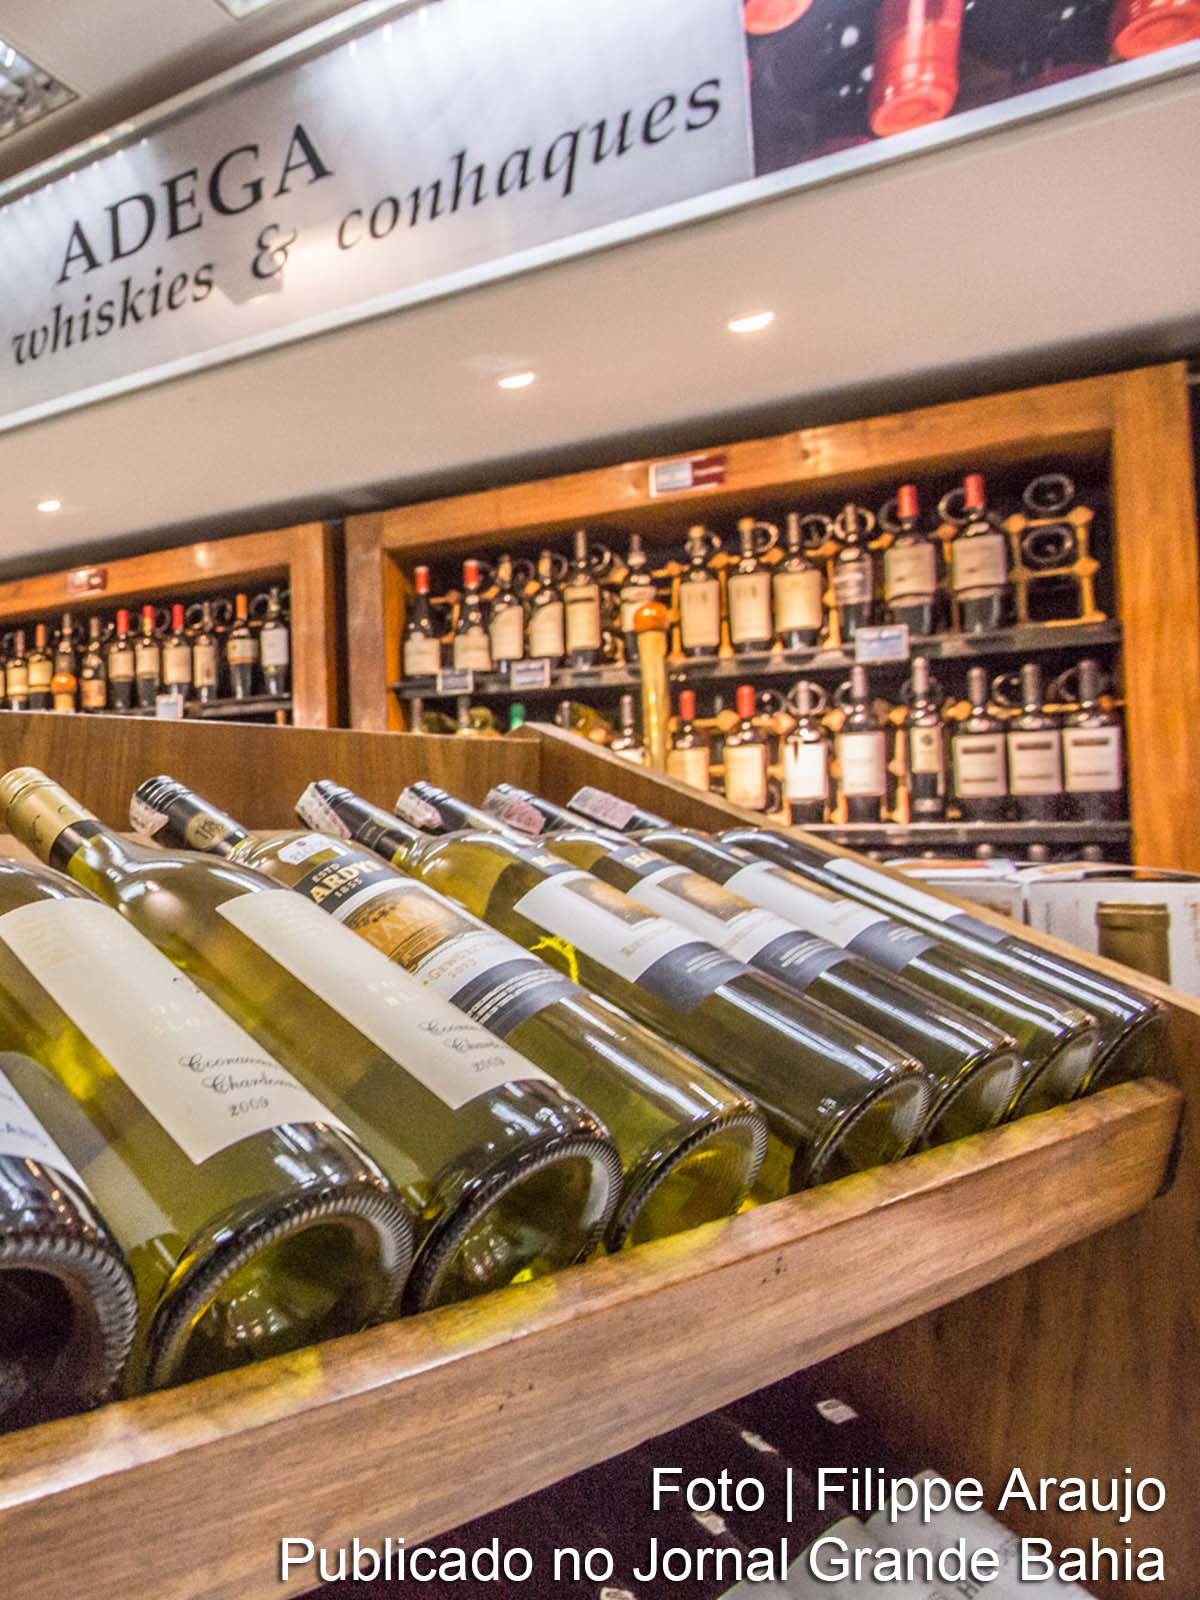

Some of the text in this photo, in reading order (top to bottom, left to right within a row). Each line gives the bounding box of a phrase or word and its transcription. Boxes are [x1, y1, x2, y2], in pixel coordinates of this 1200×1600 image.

[11, 261, 216, 366] whiskies
[251, 223, 297, 279] &
[336, 77, 722, 251] conhaques
[55, 122, 333, 285] ADEGA
